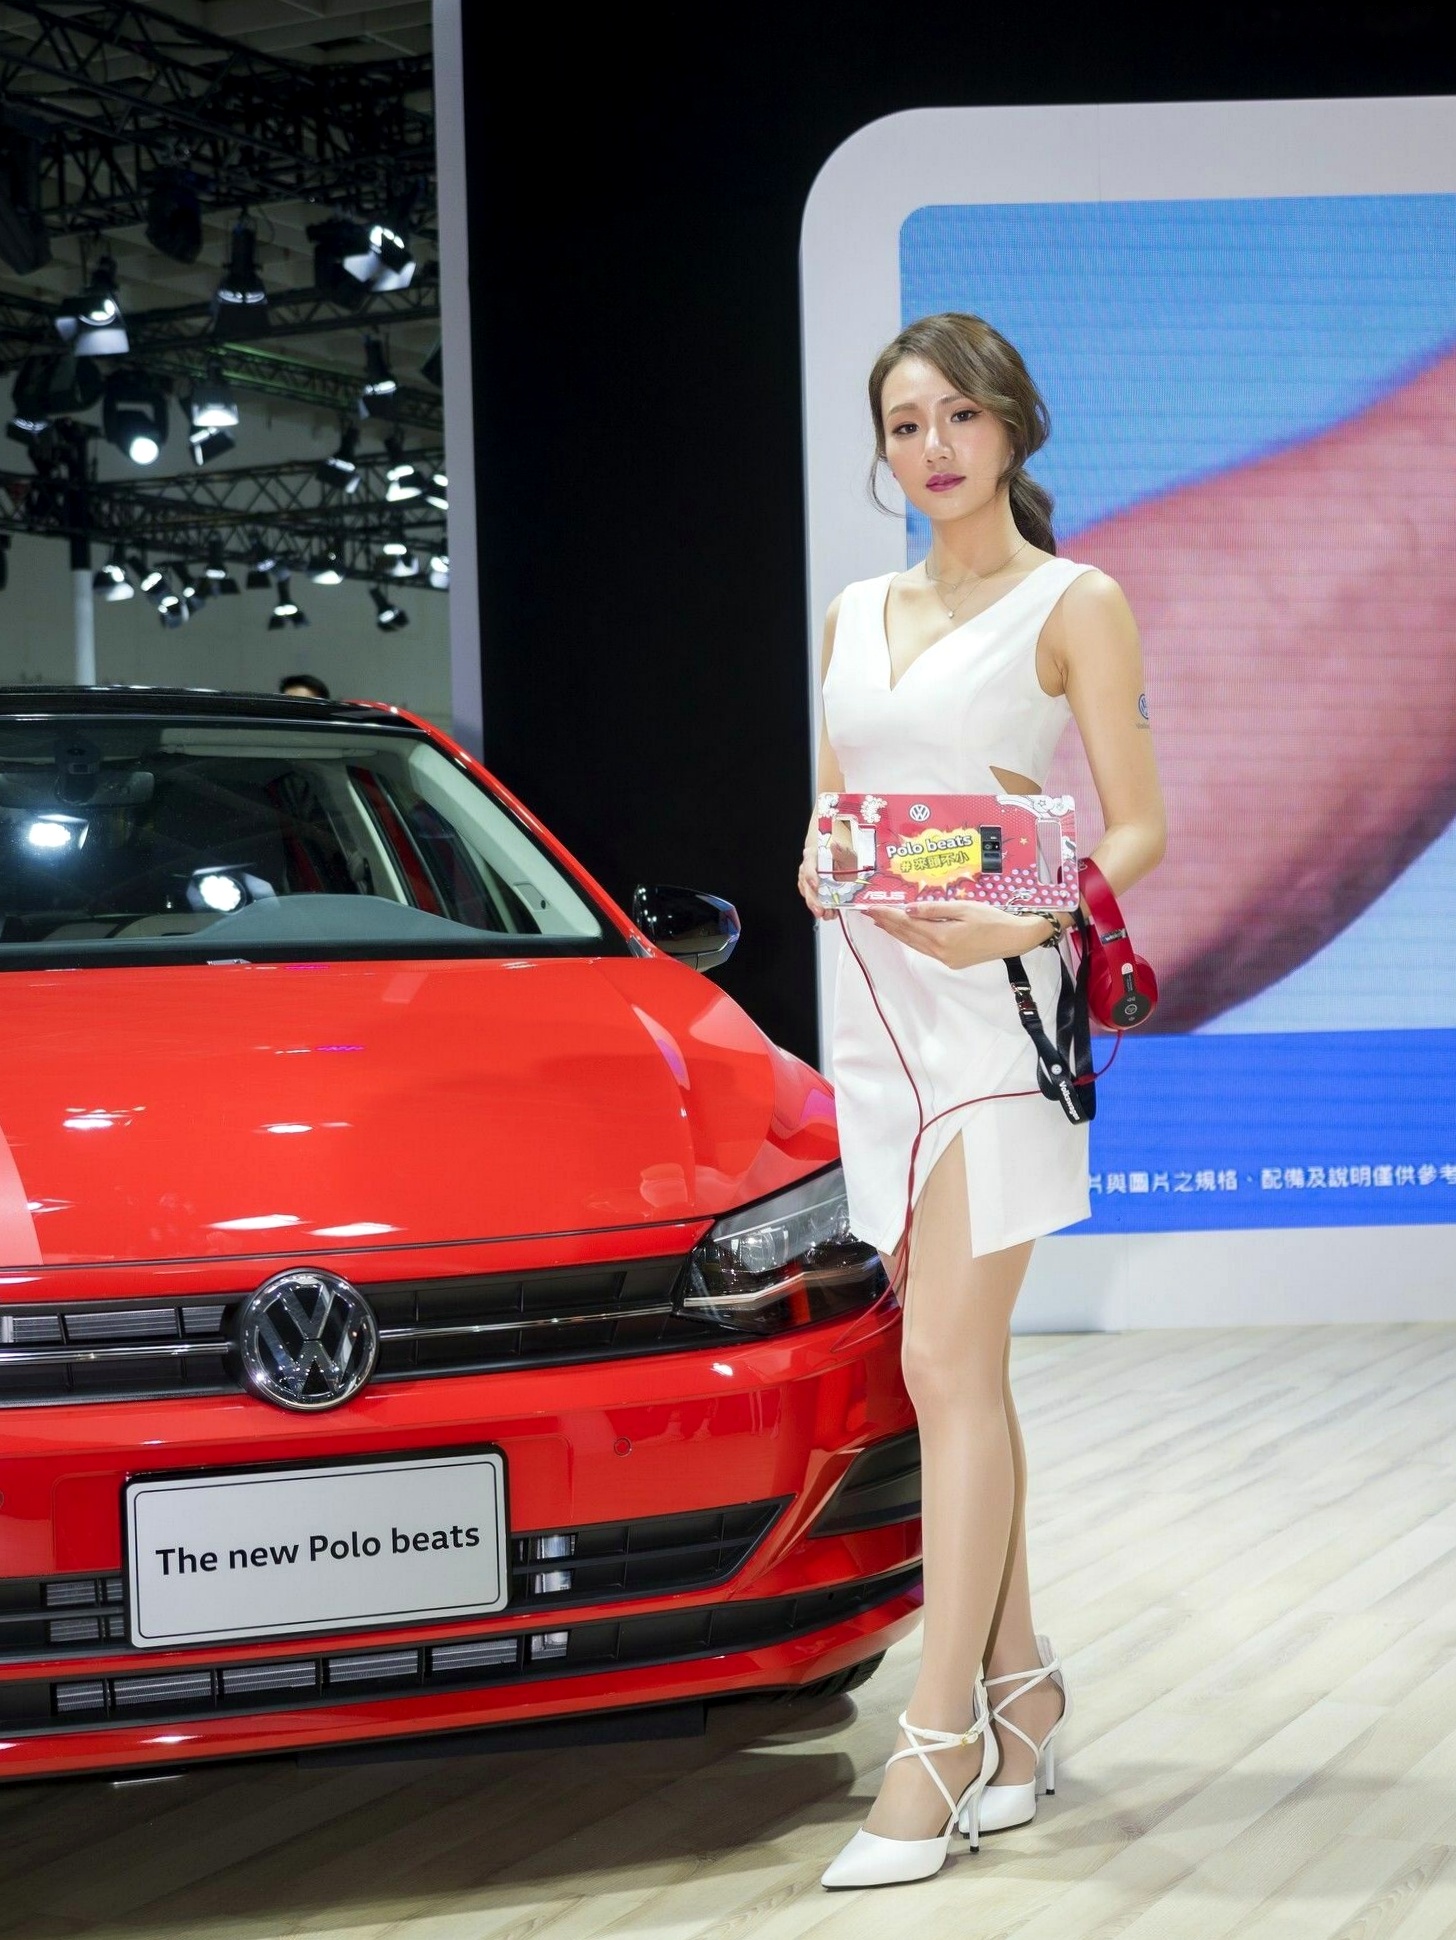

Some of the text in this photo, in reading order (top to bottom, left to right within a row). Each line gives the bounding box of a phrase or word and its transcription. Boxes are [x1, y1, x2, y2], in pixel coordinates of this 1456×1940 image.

[886, 835, 973, 858] Polo beats
[863, 890, 906, 900] ASUS
[156, 1525, 480, 1576] The new Polo beats
